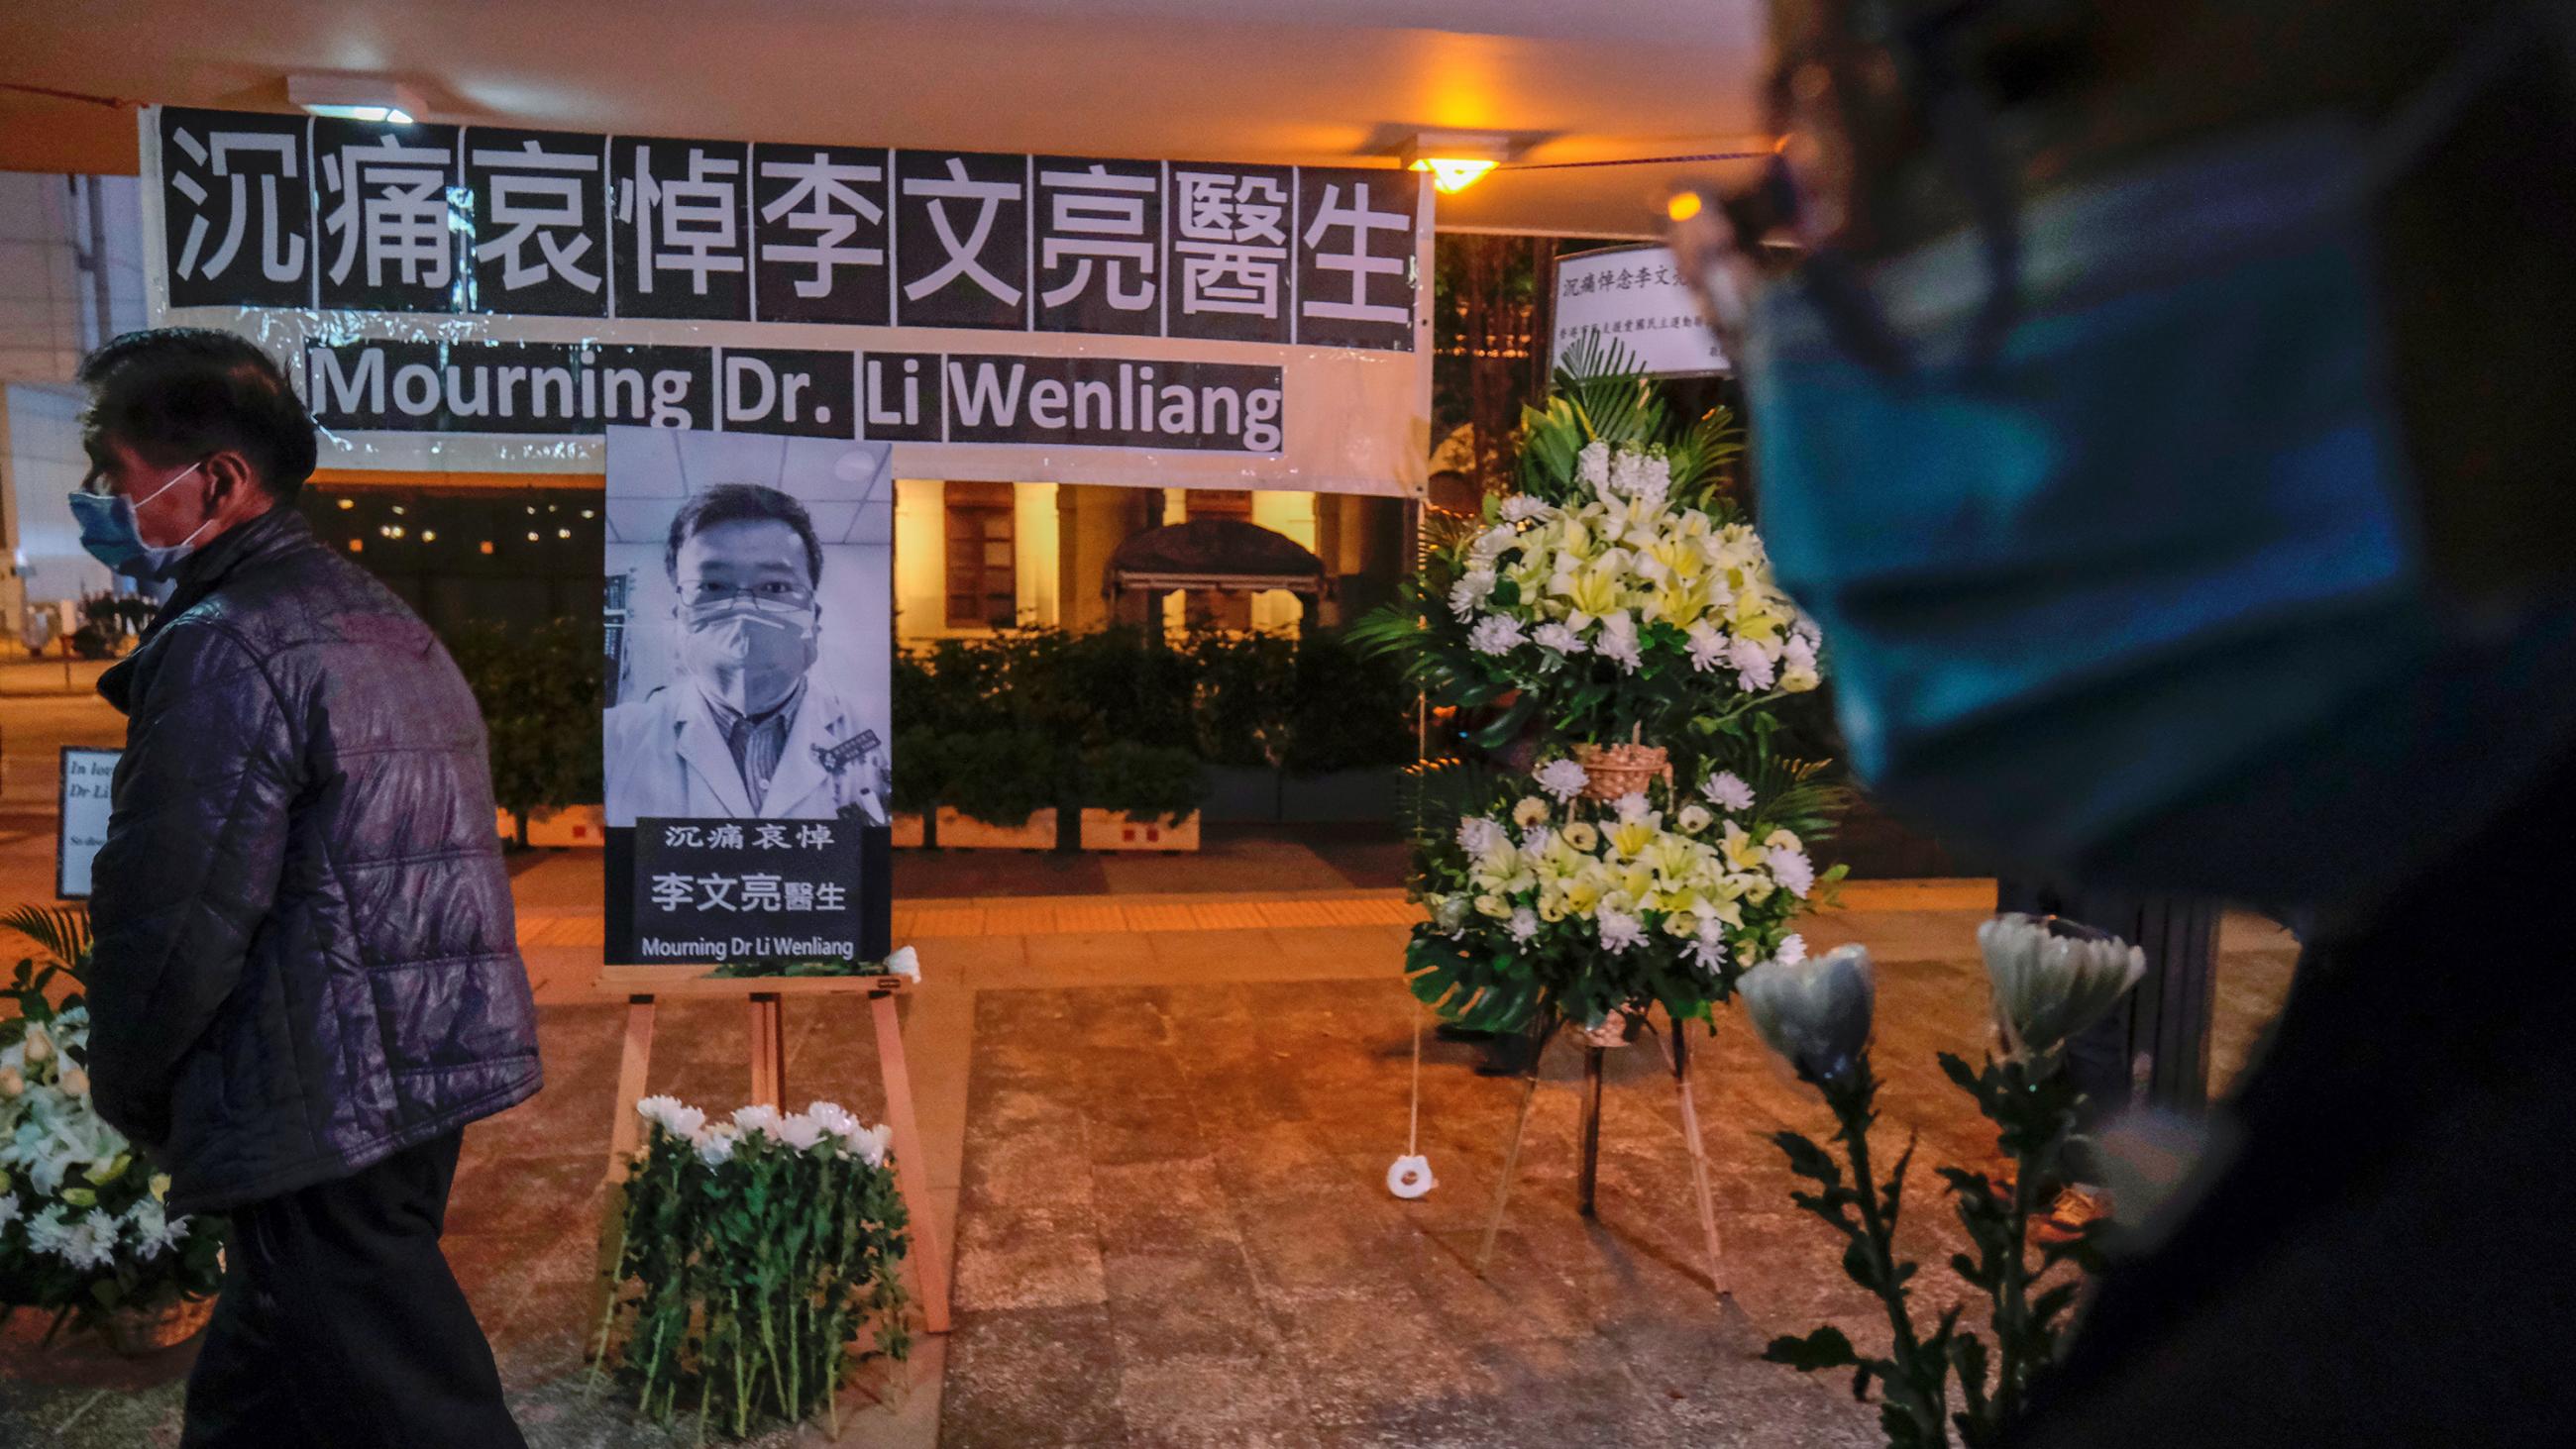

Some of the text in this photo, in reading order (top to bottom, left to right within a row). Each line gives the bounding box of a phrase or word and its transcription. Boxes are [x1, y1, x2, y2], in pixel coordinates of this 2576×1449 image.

[171, 126, 1412, 325] 沉痛哀悼李文亮醫生
[310, 347, 1282, 453] Mourning Dr. Li Wenliang
[665, 823, 835, 851] 沉痛哀悼
[651, 872, 847, 912] 李文亮醫生
[641, 937, 855, 961] Mourning Dr Li Wenliang
